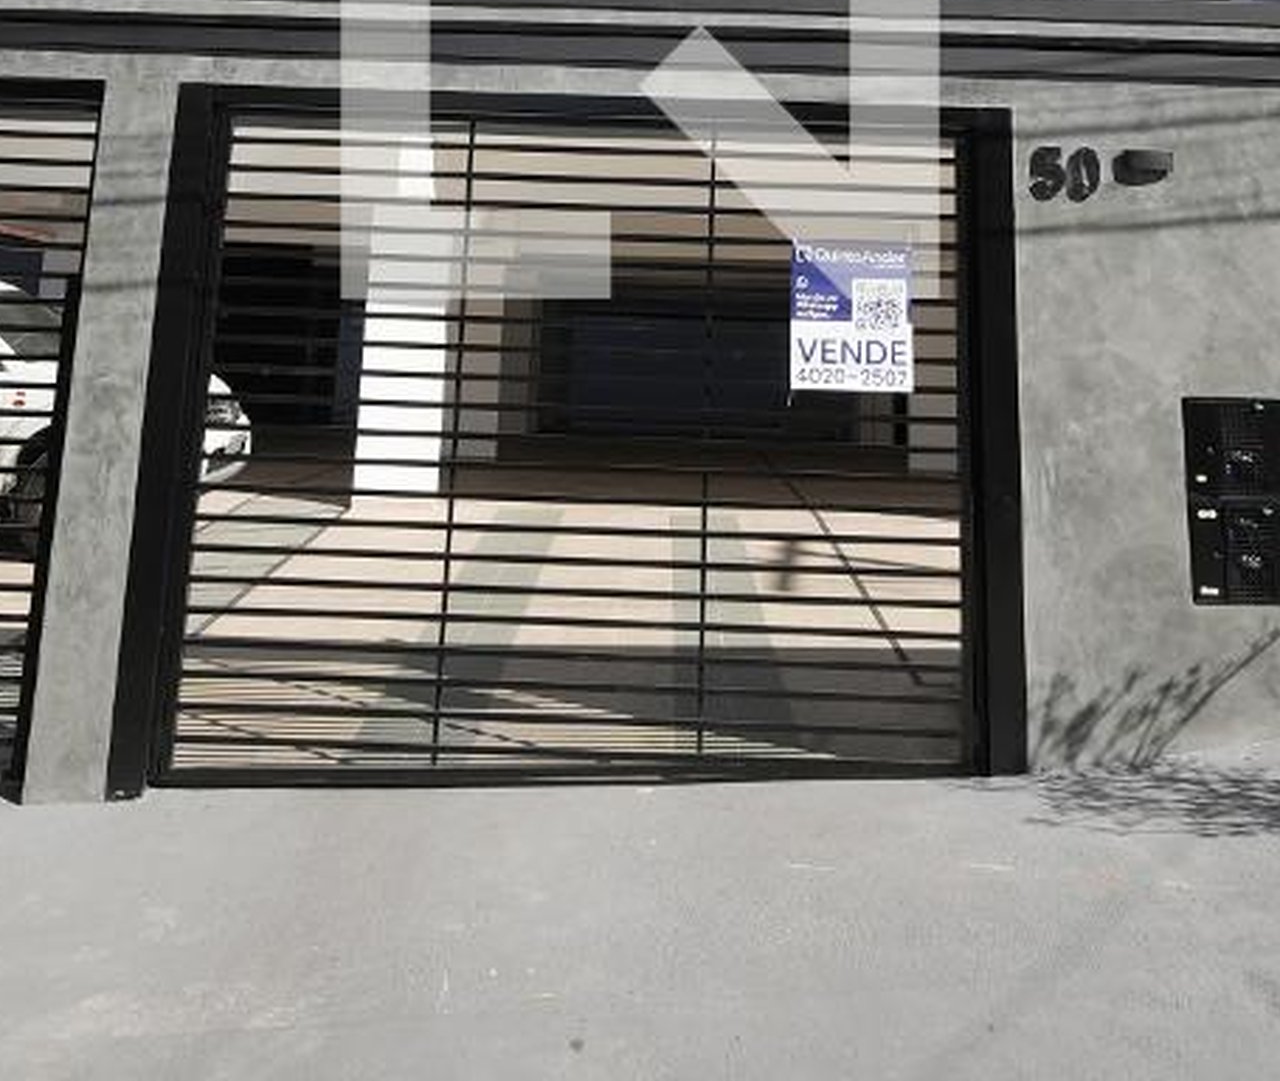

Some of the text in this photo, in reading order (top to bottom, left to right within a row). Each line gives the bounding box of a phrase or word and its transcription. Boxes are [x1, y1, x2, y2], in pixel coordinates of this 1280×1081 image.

[1029, 146, 1101, 202] 50
[797, 338, 907, 366] VENDE
[795, 368, 907, 387] 4020-2507
